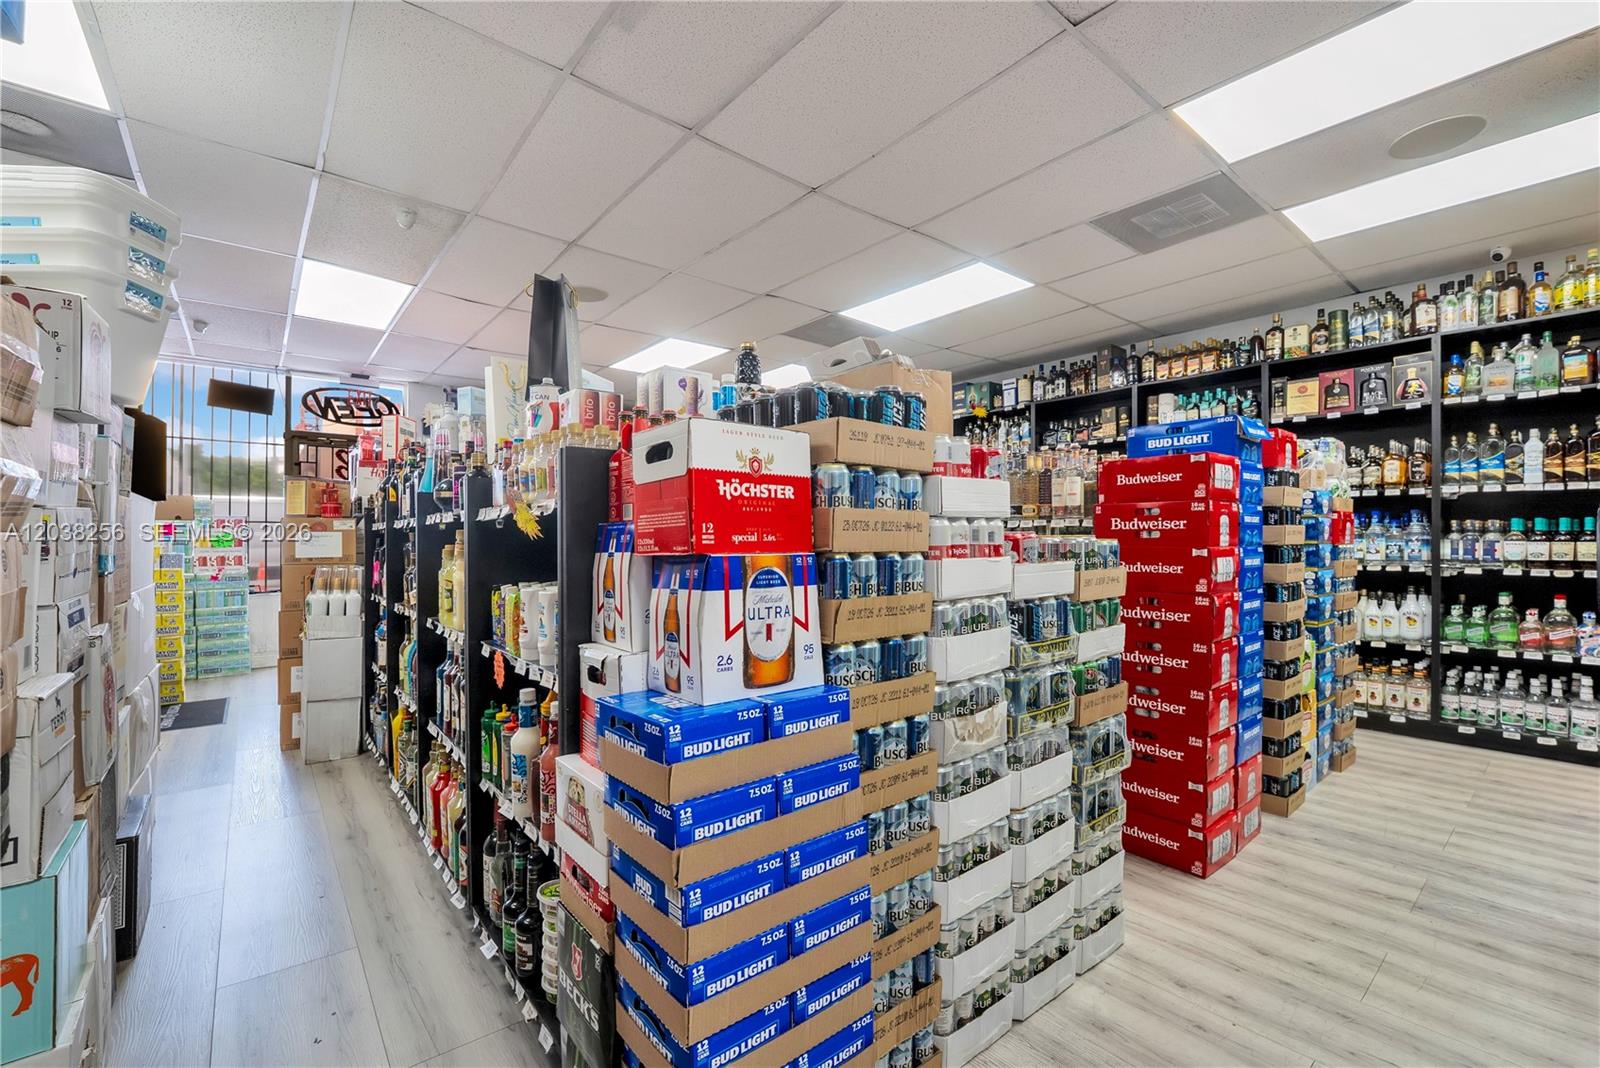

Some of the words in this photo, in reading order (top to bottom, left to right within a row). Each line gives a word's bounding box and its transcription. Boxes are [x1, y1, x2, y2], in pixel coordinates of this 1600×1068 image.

[62, 298, 72, 306] 12
[584, 398, 594, 419] brio
[606, 401, 616, 422] brio
[1148, 438, 1172, 449] BUD
[1174, 434, 1210, 447] LIGHT
[1116, 472, 1183, 486] Budweiser
[716, 478, 795, 500] HÖCHSTER
[702, 523, 714, 533] 12
[1110, 518, 1188, 530] Budweiser
[732, 532, 758, 544] special
[748, 606, 792, 621] ULTRA
[803, 644, 814, 654] 95
[716, 655, 733, 666] 2.6
[1122, 650, 1189, 669] udweiser
[686, 675, 694, 686] 95
[828, 694, 838, 704] 7.5
[1128, 694, 1186, 716] dweiser
[773, 705, 784, 714] 12
[737, 711, 748, 721] 7.5
[644, 722, 652, 732] 7.5
[668, 724, 681, 734] 12
[785, 720, 808, 736] BUD
[809, 714, 840, 730] LIGHT
[684, 740, 712, 758] BUD
[714, 732, 750, 752] LIGHT
[1128, 738, 1184, 762] dweiser
[838, 762, 848, 772] 7.5
[783, 778, 793, 787] 12
[749, 788, 761, 799] 7.5
[794, 792, 818, 808] BUD
[819, 782, 849, 800] LIGHT
[568, 804, 587, 823] STELLA
[680, 808, 692, 818] 12
[694, 822, 723, 841] BUD
[725, 808, 762, 831] LIGHT
[845, 830, 854, 840] 7.5
[790, 850, 800, 860] 12
[757, 862, 769, 874] 7.5
[802, 862, 824, 880] BUD
[826, 849, 856, 870] LIGHT
[636, 873, 652, 896] BUD
[689, 888, 702, 900] 12
[850, 894, 859, 906] 7.5
[703, 899, 733, 921] BUD
[734, 884, 771, 908] LIGHT
[794, 920, 804, 930] 12
[806, 930, 829, 949] BUD
[830, 914, 861, 937] LIGHT
[761, 934, 773, 946] 7.5
[692, 965, 704, 977] 12
[706, 974, 736, 997] BUD
[737, 955, 774, 981] LIGHT
[796, 987, 806, 996] 12
[808, 997, 831, 1016] BUD
[832, 977, 862, 1002] LIGHT
[560, 965, 600, 1032] BECK'S
[764, 1002, 776, 1016] 7.5
[852, 1020, 862, 1032] 7.5
[741, 1024, 777, 1053] LIGHT
[697, 1040, 709, 1052] 12
[833, 1038, 864, 1066] LIGHT
[799, 1054, 808, 1065] 12
